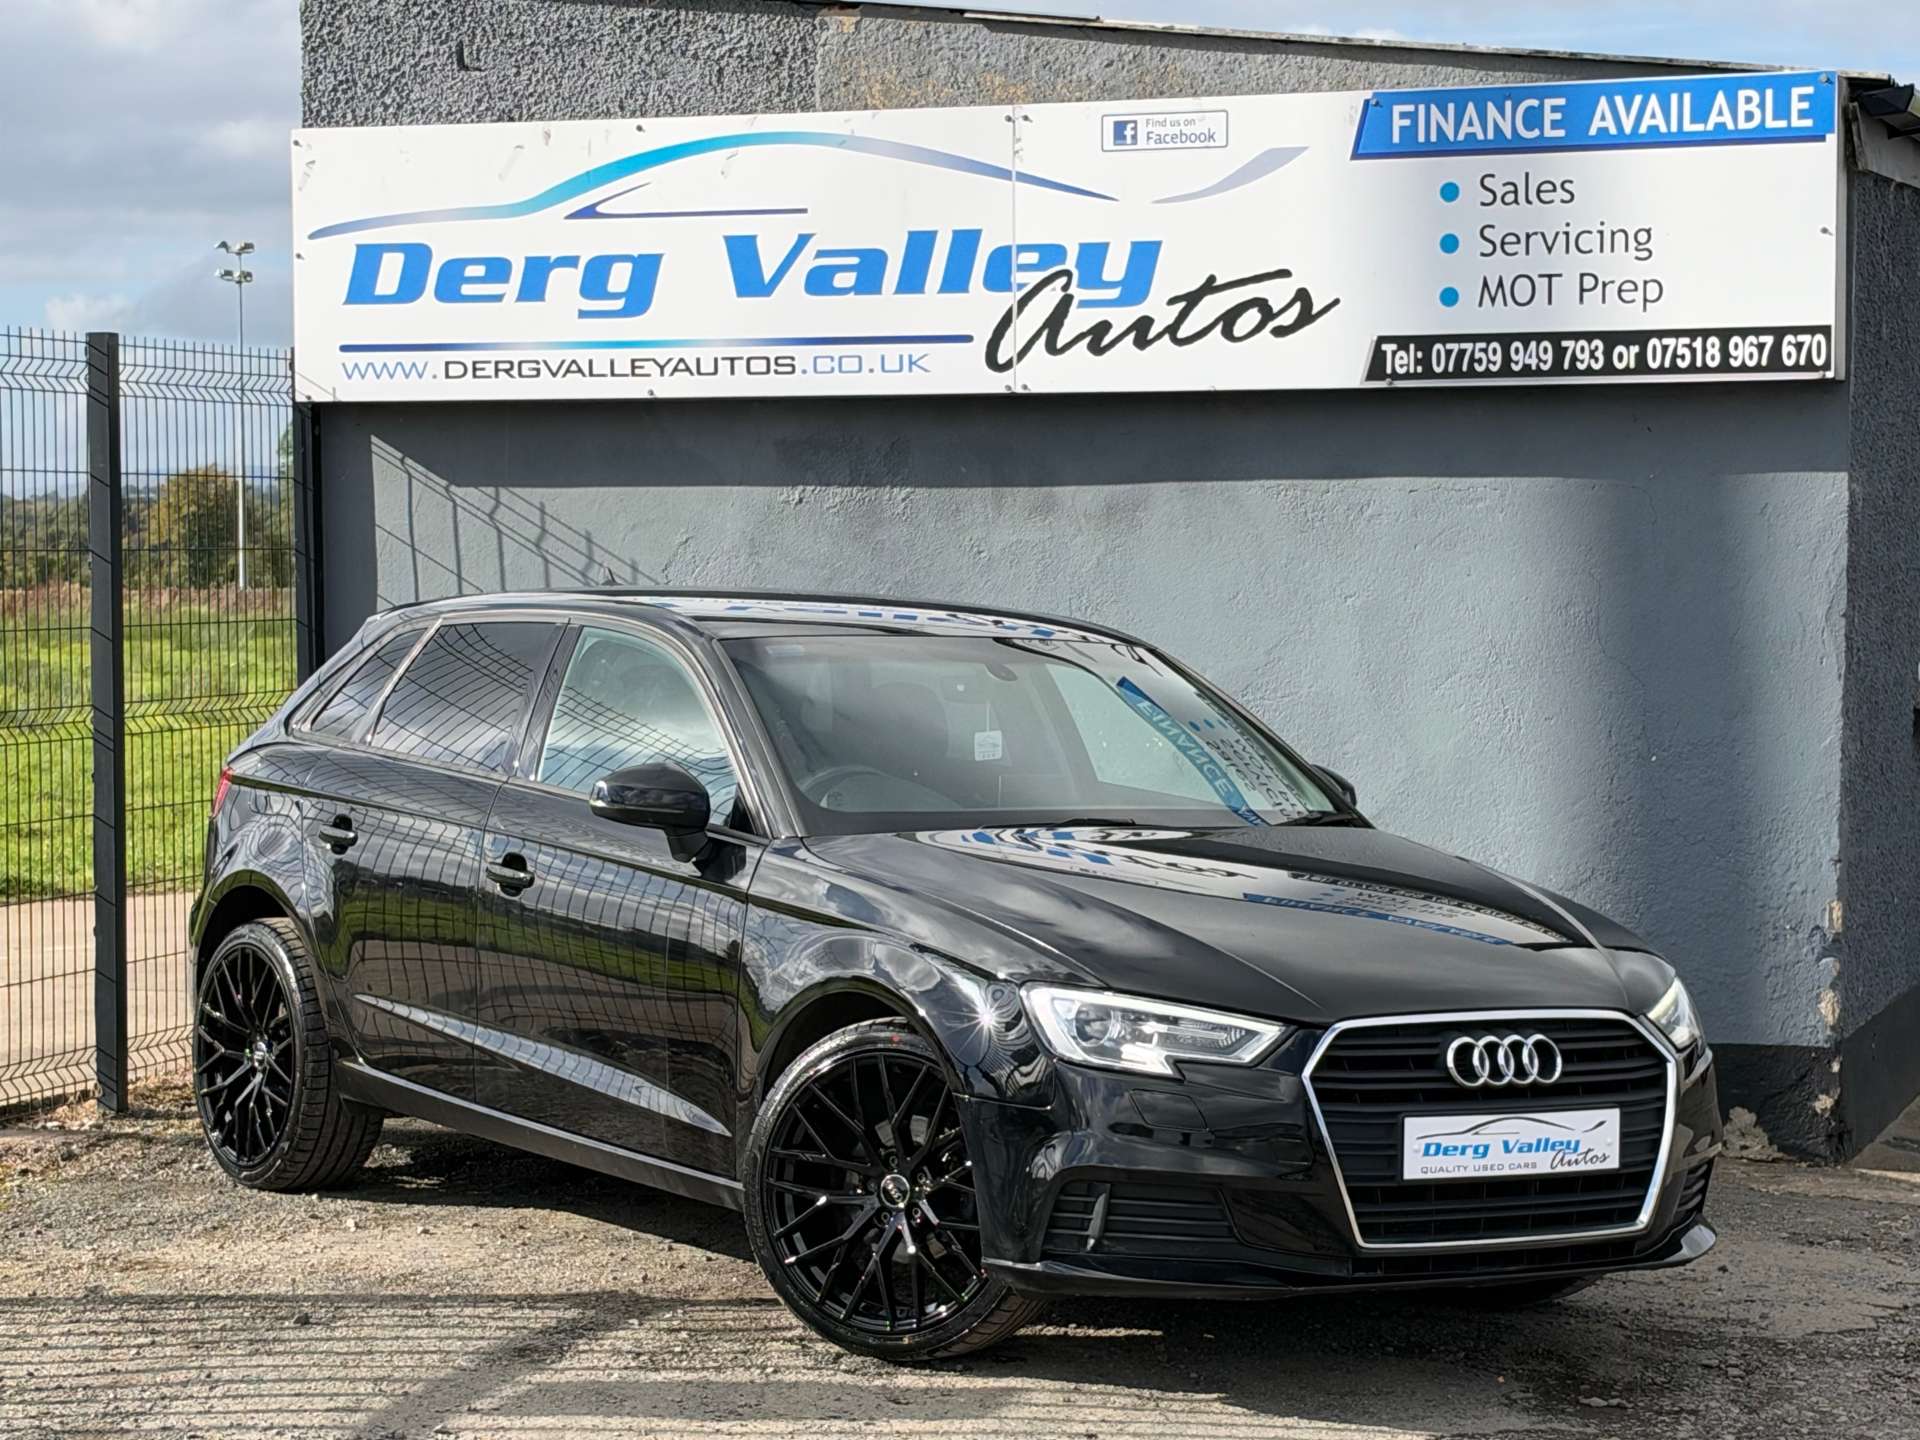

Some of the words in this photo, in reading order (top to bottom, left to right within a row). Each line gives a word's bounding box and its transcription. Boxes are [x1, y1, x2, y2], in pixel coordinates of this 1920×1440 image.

[1145, 118, 1167, 128] Find
[1169, 118, 1181, 127] us
[1183, 117, 1196, 127] on
[1391, 96, 1566, 144] FINANCE
[1588, 86, 1814, 136] AVAILABLE
[1146, 128, 1216, 145] Facebook
[1479, 172, 1576, 207] Sales
[1479, 221, 1653, 261] Servicing
[343, 242, 664, 319] Derg
[723, 228, 1163, 309] Valley
[1478, 273, 1563, 308] MOT
[1579, 272, 1665, 312] Prep
[985, 269, 1341, 373] Autos
[1381, 343, 1424, 375] Tel:
[1432, 342, 1501, 372] 07759
[1511, 340, 1553, 370] 949
[1561, 340, 1604, 369] 793
[1613, 345, 1639, 368] or
[1647, 338, 1720, 368] 07518
[1729, 336, 1773, 366] 967
[1782, 334, 1826, 366] 670
[1422, 1142, 1491, 1160] Derg
[1503, 1137, 1580, 1154] Valley
[1550, 1149, 1610, 1170] Autos
[1421, 1165, 1468, 1175] QUALITY
[1473, 1164, 1504, 1172] USED
[1509, 1162, 1537, 1170] CARS
